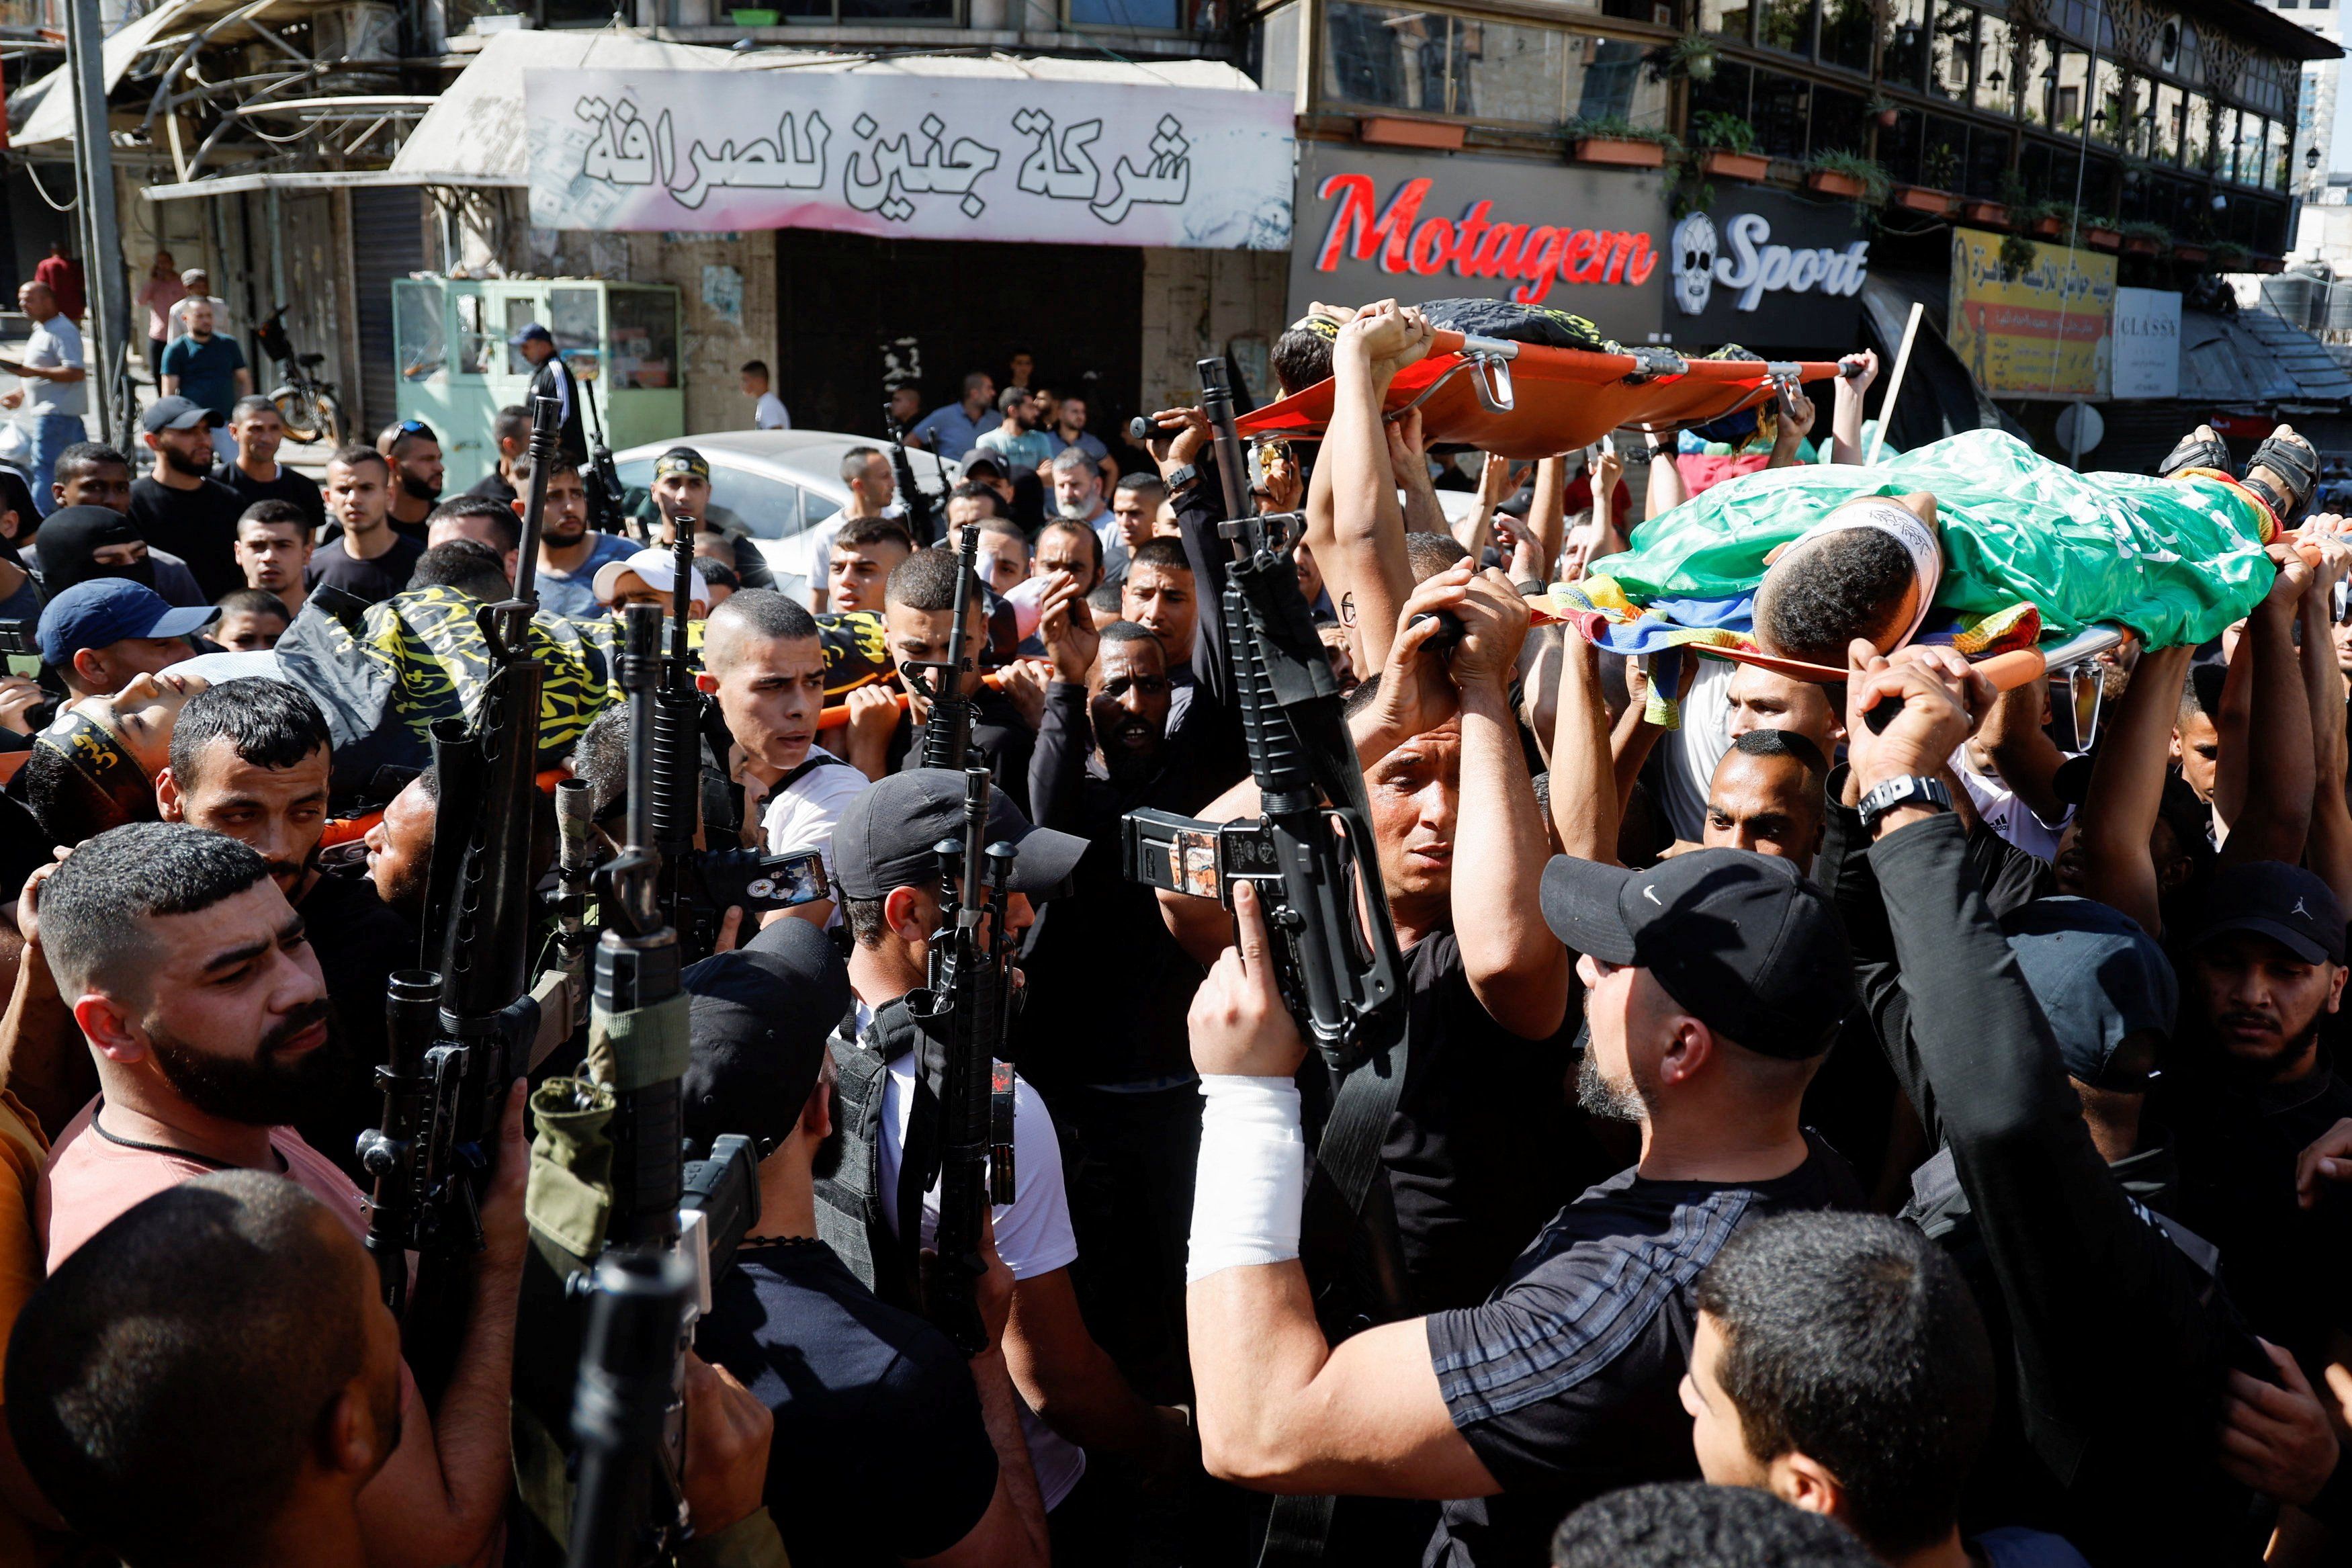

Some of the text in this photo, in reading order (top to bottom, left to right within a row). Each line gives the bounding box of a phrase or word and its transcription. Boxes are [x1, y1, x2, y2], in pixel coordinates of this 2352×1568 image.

[574, 95, 1190, 225] شركة جنين للصرافة
[1317, 173, 1870, 312] Motagem Sport
